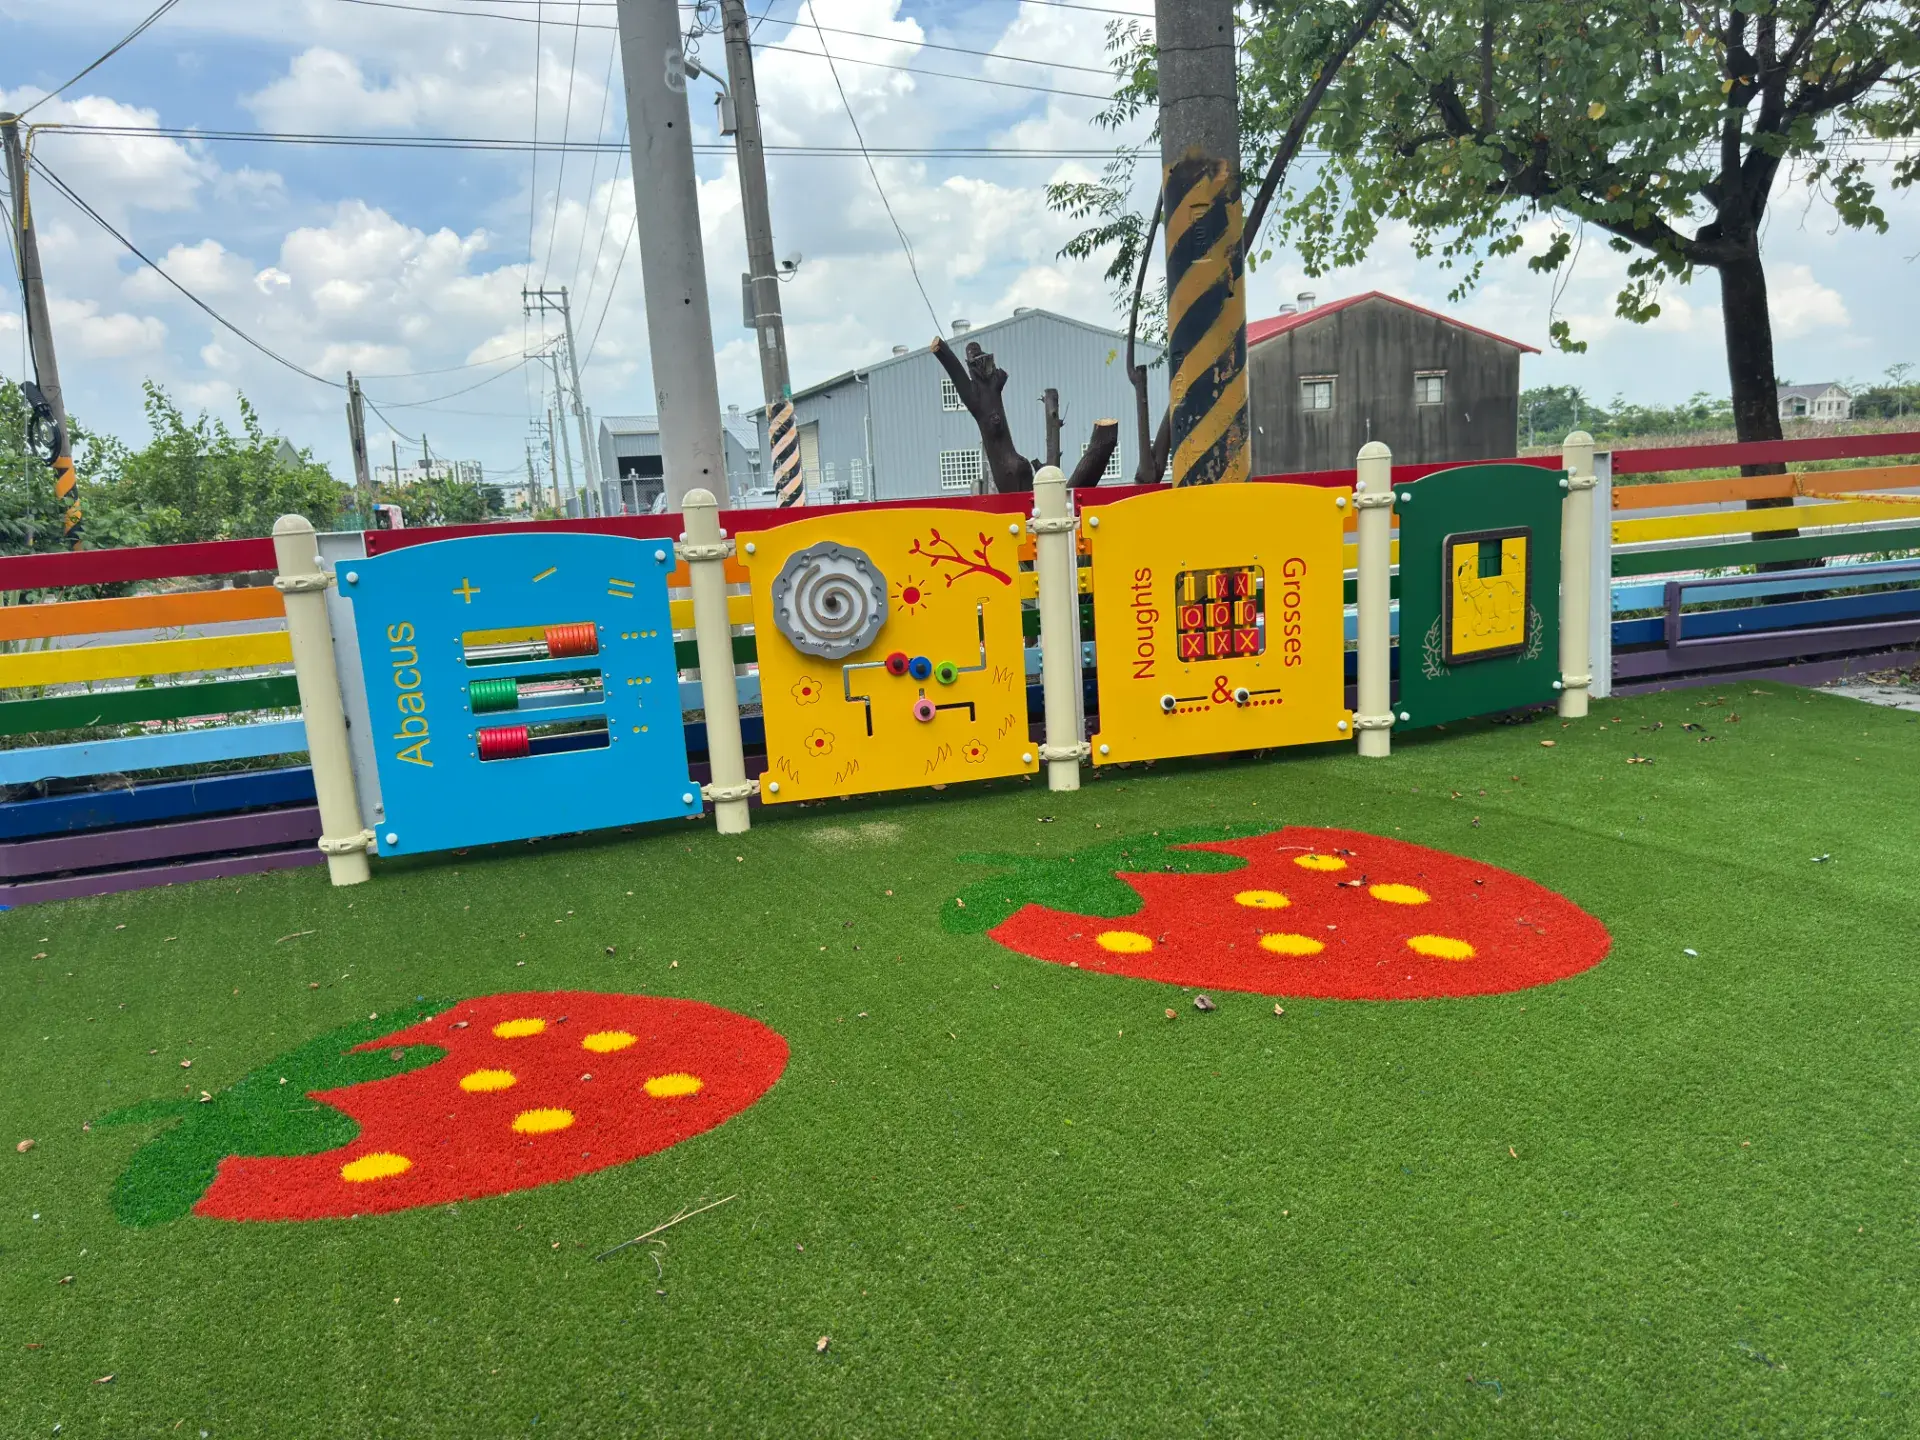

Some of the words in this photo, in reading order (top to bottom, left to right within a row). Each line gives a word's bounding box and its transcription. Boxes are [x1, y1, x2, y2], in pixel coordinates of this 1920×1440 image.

[1130, 567, 1159, 680] Noughts
[1282, 557, 1307, 668] Grosses
[386, 620, 434, 767] Abacus
[1211, 675, 1234, 704] &
